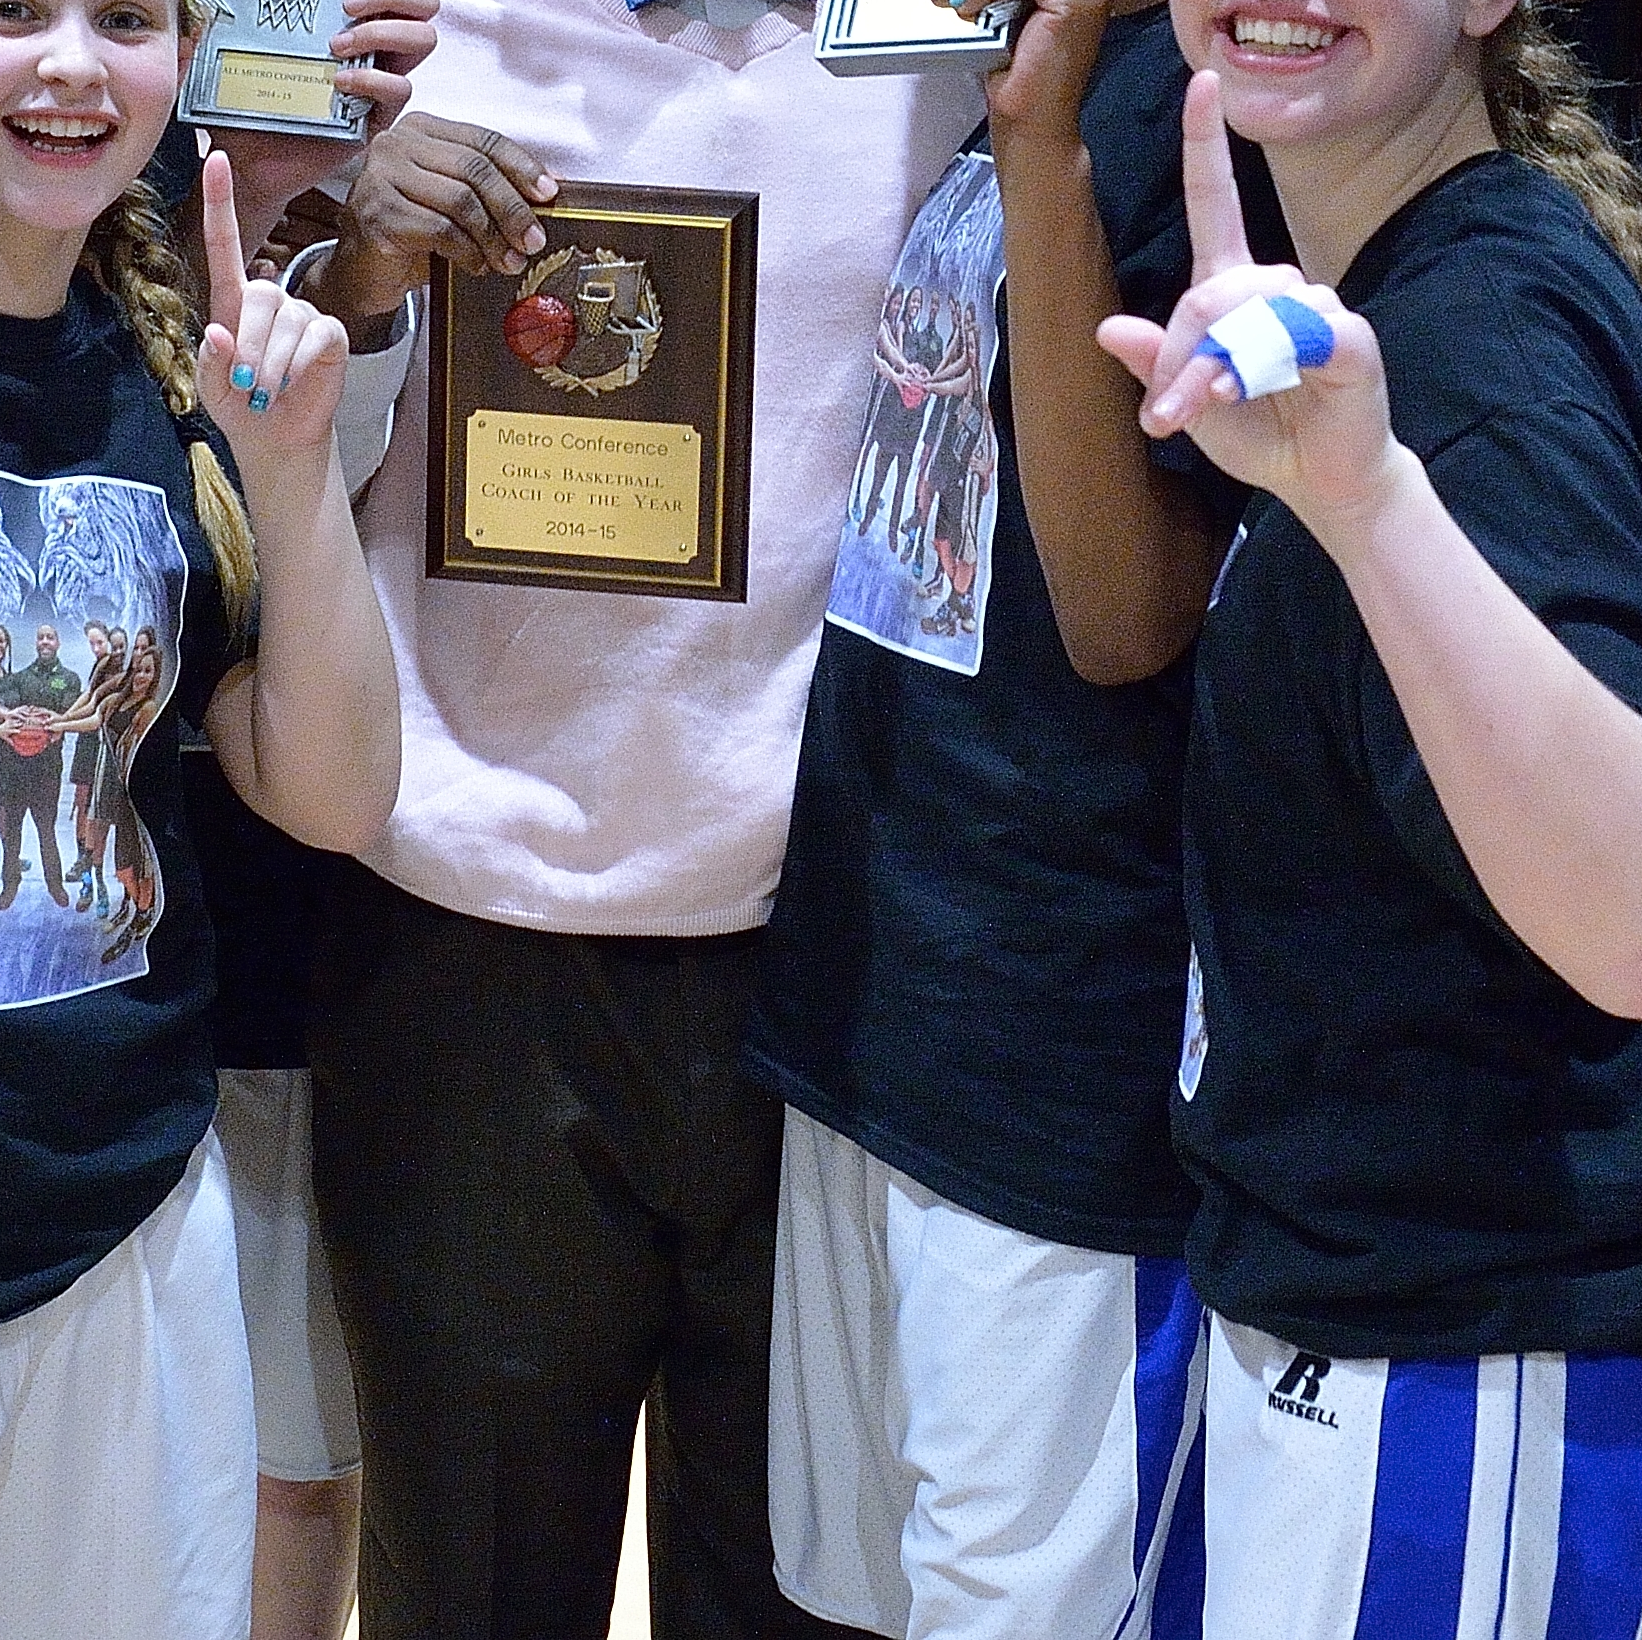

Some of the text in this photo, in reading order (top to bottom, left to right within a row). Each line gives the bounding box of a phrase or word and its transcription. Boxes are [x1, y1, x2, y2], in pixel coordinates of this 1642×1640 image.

[222, 66, 237, 75] ALL
[242, 68, 273, 79] METRO
[257, 89, 276, 98] 2014
[497, 428, 669, 457] Metro Conference
[546, 520, 617, 540] 2014-15
[1267, 1390, 1339, 1430] RUSSELL
